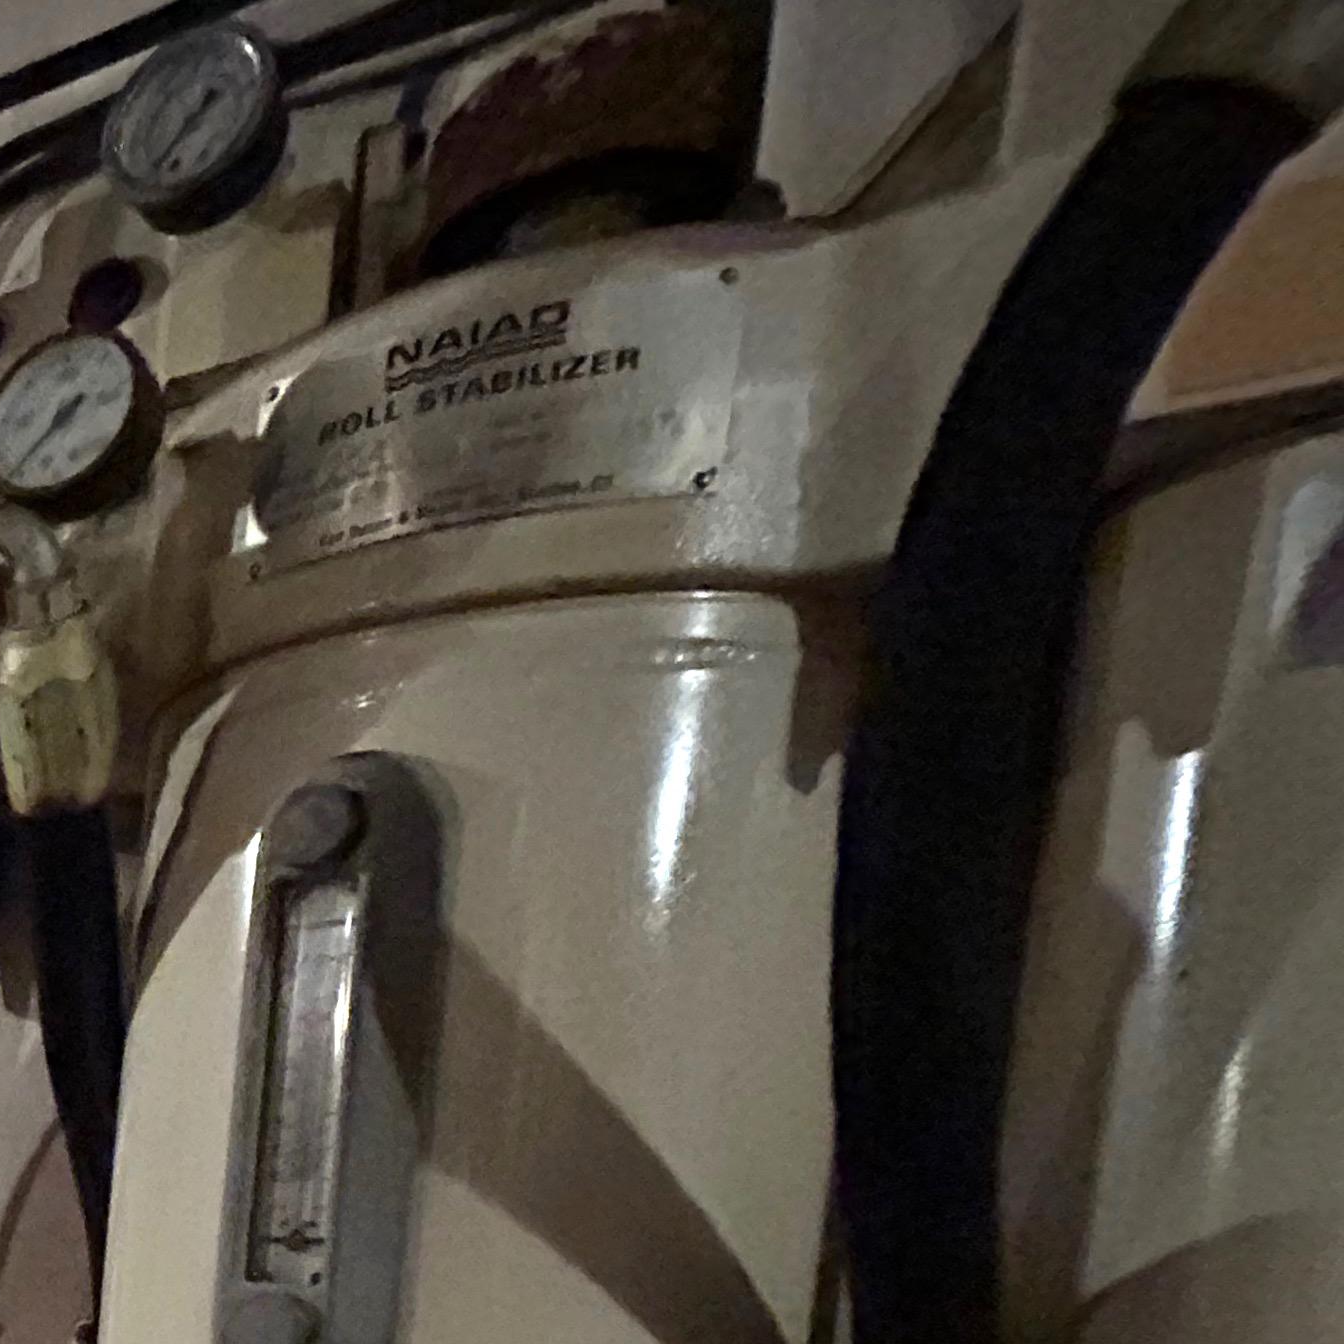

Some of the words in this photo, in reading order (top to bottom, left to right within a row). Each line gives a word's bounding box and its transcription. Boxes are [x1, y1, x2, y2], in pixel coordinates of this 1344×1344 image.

[385, 301, 570, 369] NAIAD
[318, 401, 401, 446] ROLL
[414, 346, 641, 414] STABILIZER
